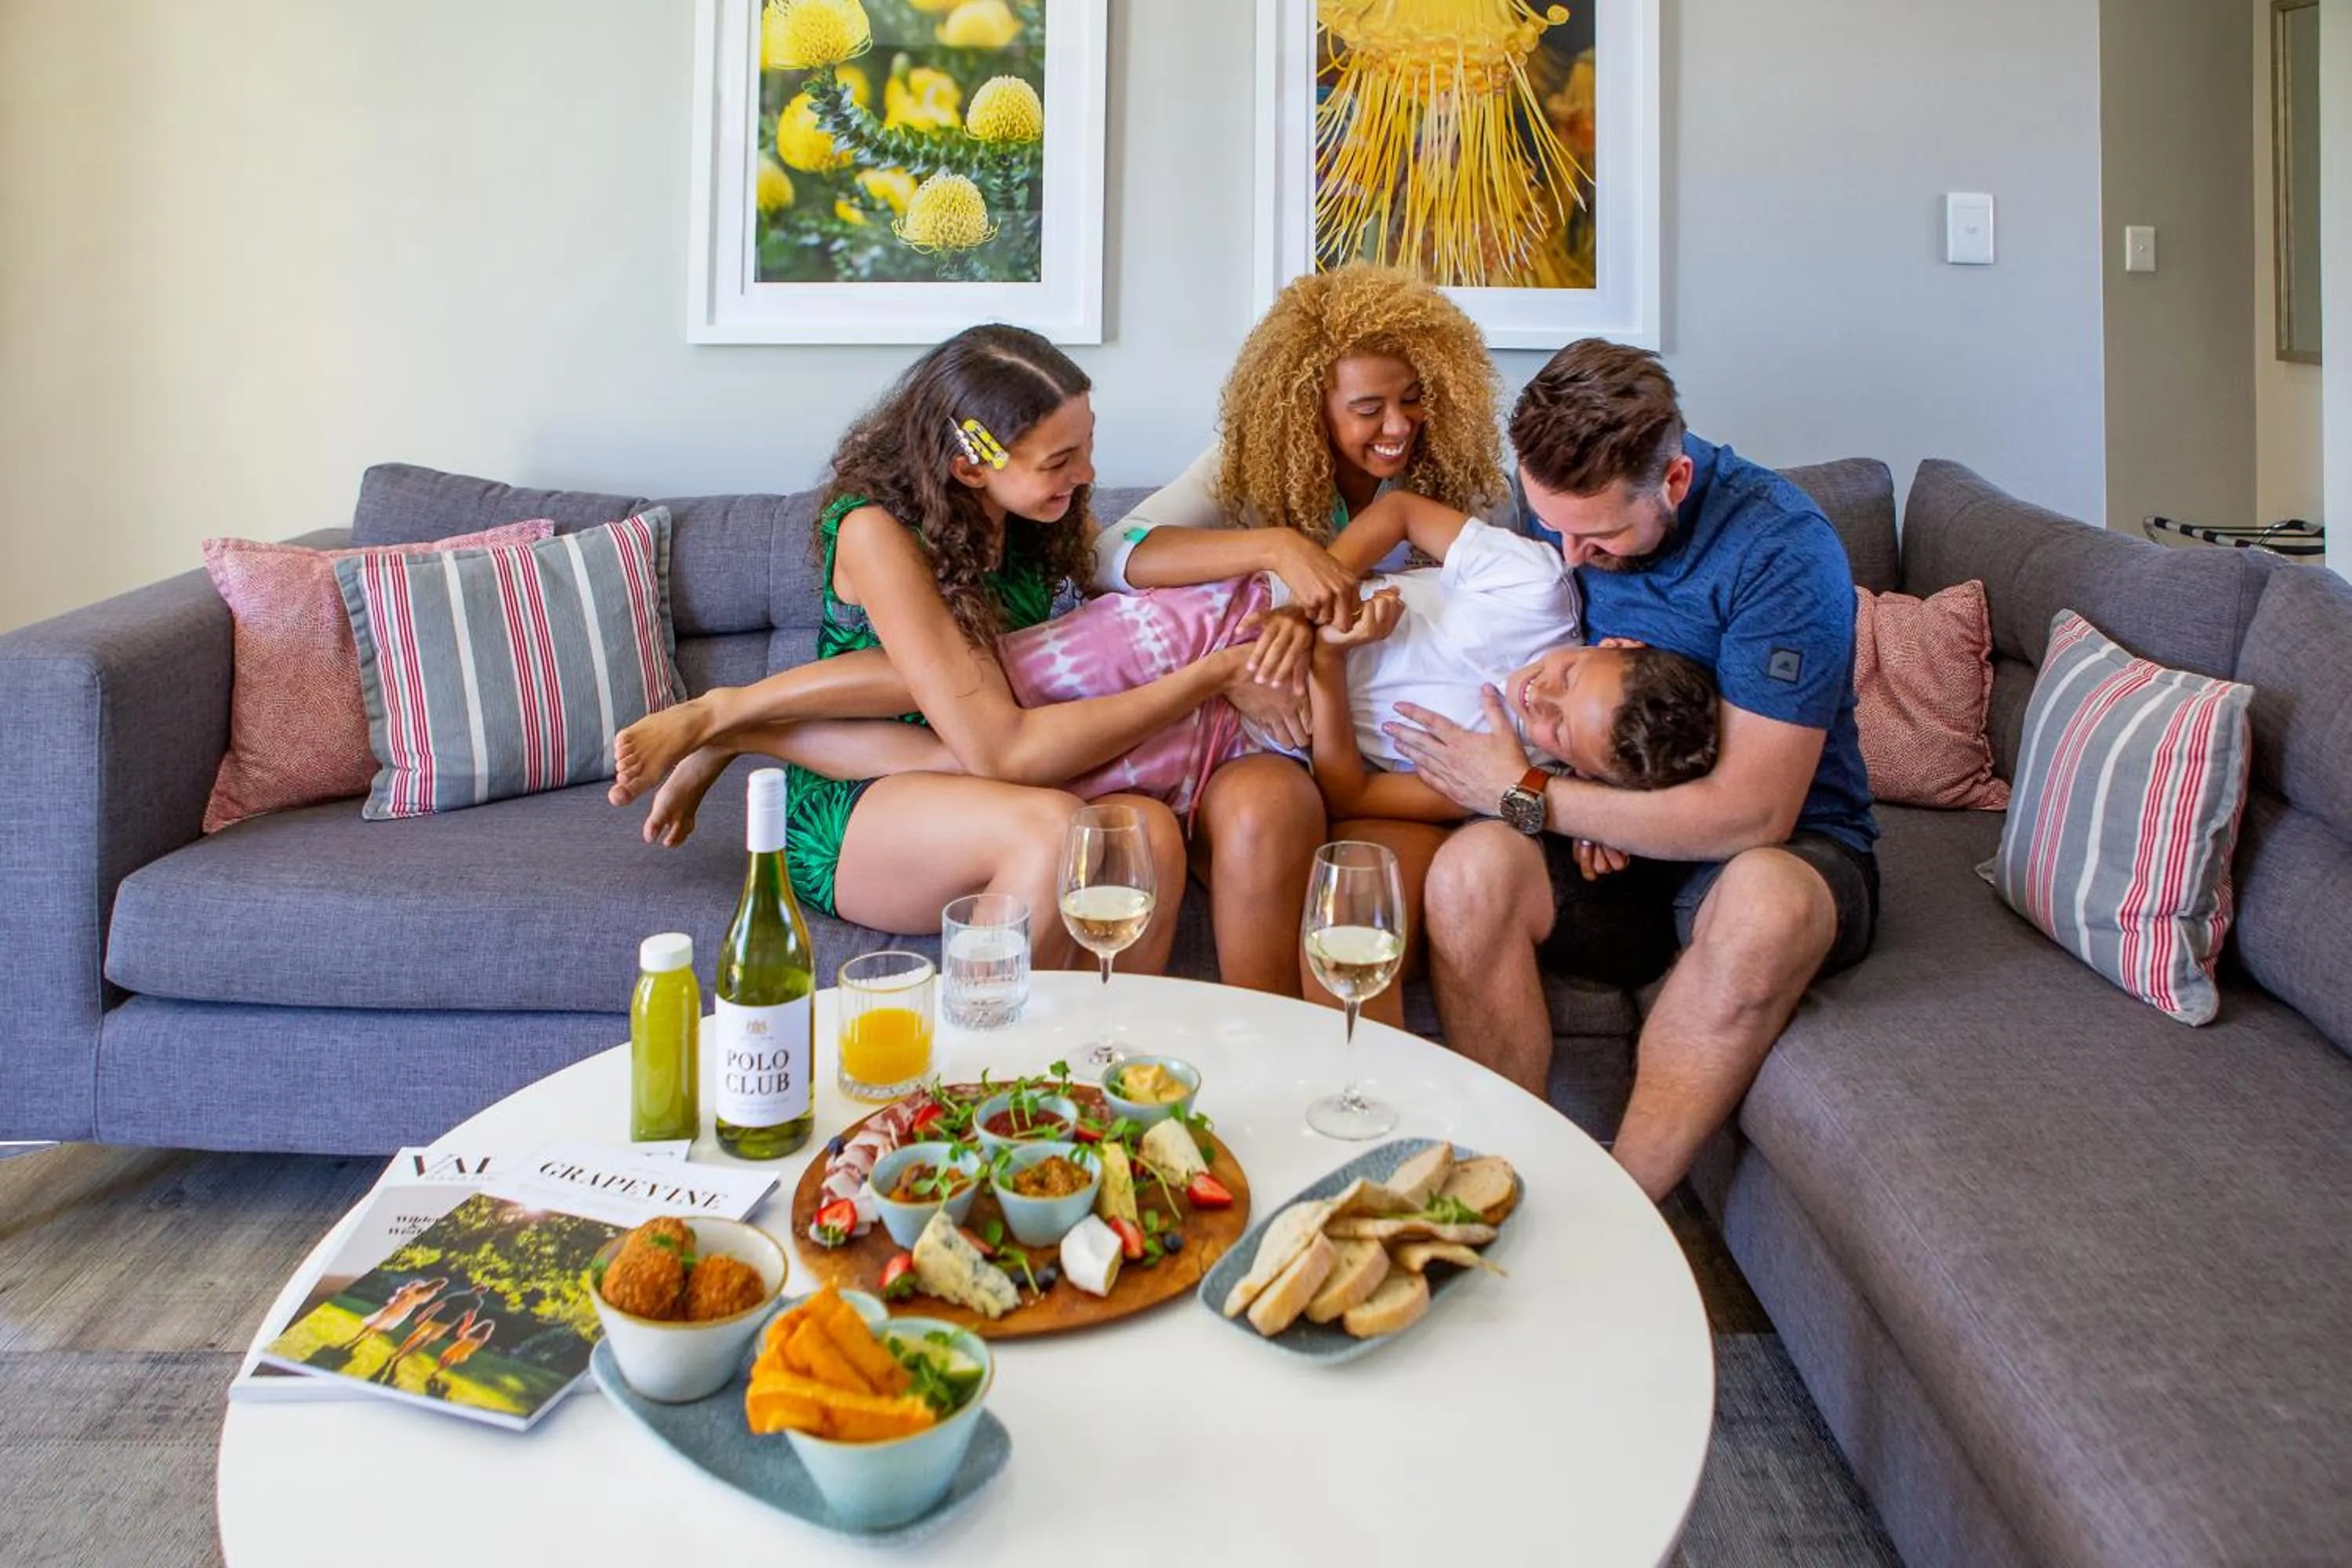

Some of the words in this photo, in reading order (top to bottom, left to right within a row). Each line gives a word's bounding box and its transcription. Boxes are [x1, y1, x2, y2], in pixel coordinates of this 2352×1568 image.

[727, 1048, 790, 1072] POLO
[725, 1072, 791, 1096] CLUB
[539, 1161, 728, 1210] GRAPEVINE
